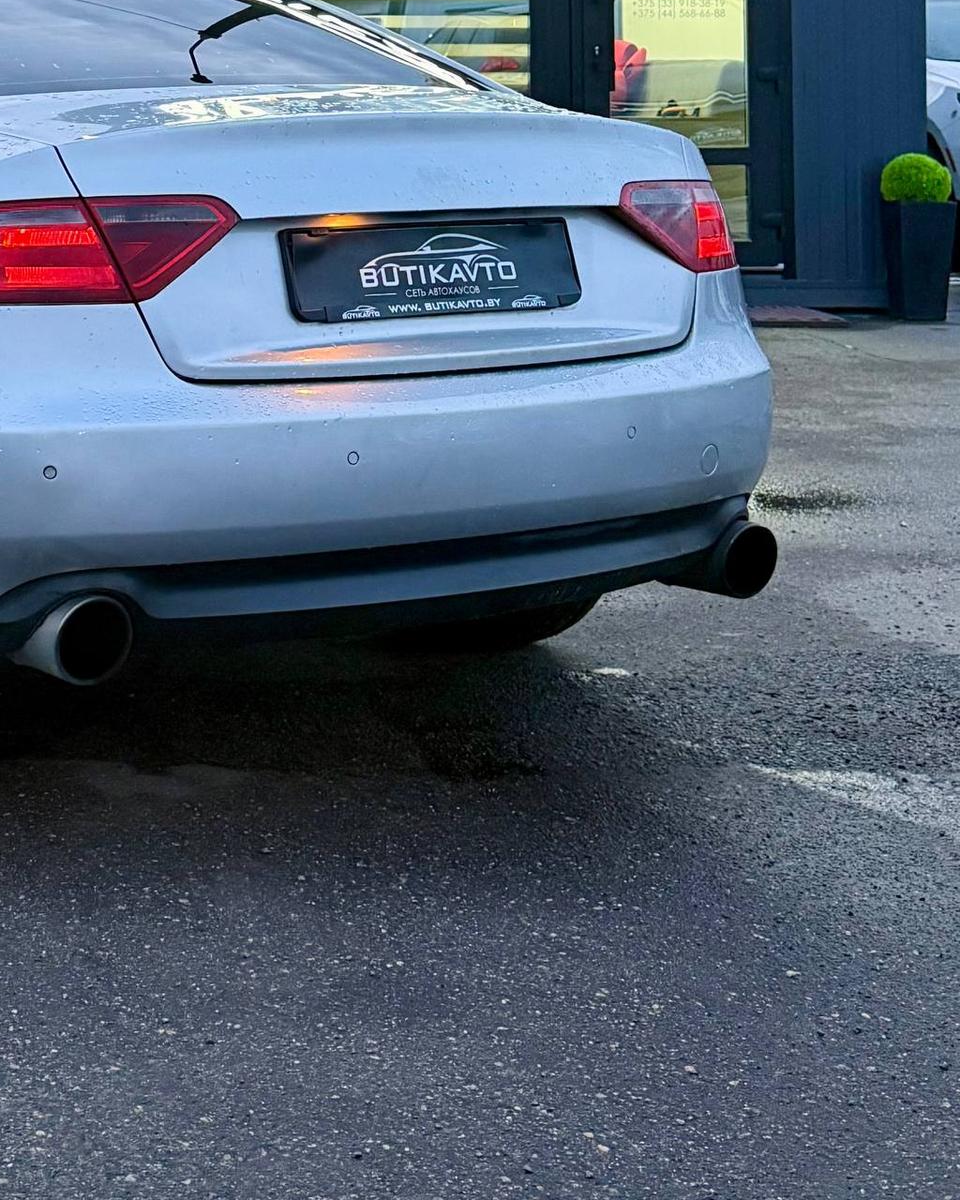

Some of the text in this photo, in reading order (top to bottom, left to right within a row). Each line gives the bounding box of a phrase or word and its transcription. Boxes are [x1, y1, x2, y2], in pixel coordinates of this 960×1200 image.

[632, 0, 655, 8] +375
[632, 9, 655, 18] +375
[359, 261, 517, 288] BUTIKAVTO
[405, 285, 481, 298] СЕТЬ АВТОХАУСОВ
[388, 303, 422, 314] WWW.
[424, 298, 501, 311] BUTIKAVTO.BY
